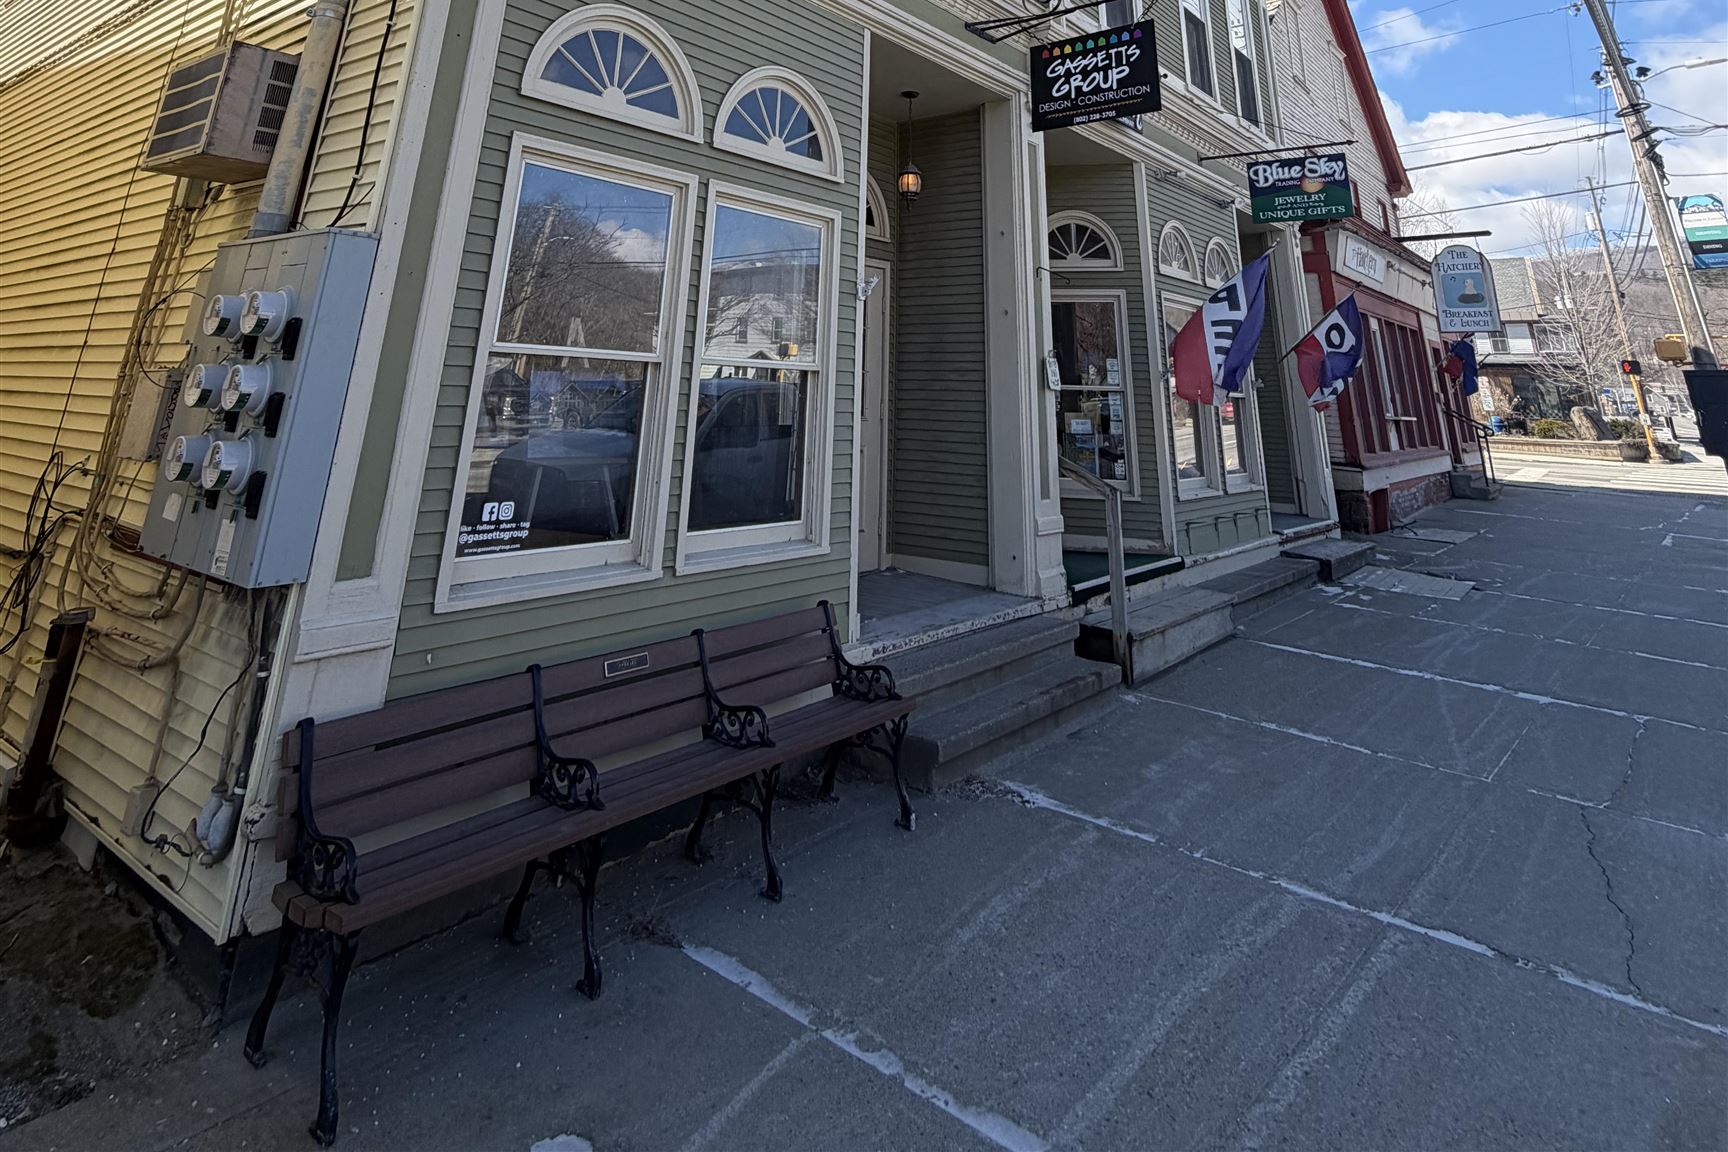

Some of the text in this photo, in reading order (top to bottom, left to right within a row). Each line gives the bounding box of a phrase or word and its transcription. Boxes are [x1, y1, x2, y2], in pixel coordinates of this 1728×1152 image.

[1046, 44, 1141, 78] GASSETTS
[1051, 65, 1130, 99] GROUP
[1039, 84, 1151, 113] DESIGN CONSTRUCTION
[1073, 115, 1089, 124] (802)
[1249, 157, 1346, 188] Blue Sky
[1275, 179, 1301, 187] TRADING
[1273, 193, 1327, 206] JEWELRY
[1259, 205, 1346, 220] UNIQUE GIFTS
[1447, 250, 1469, 260] THE
[1442, 309, 1493, 319] BREAKFAST
[1449, 318, 1490, 328] & LUNCH
[460, 521, 530, 532] like follow share tag
[458, 529, 529, 545] @gassettsgroup
